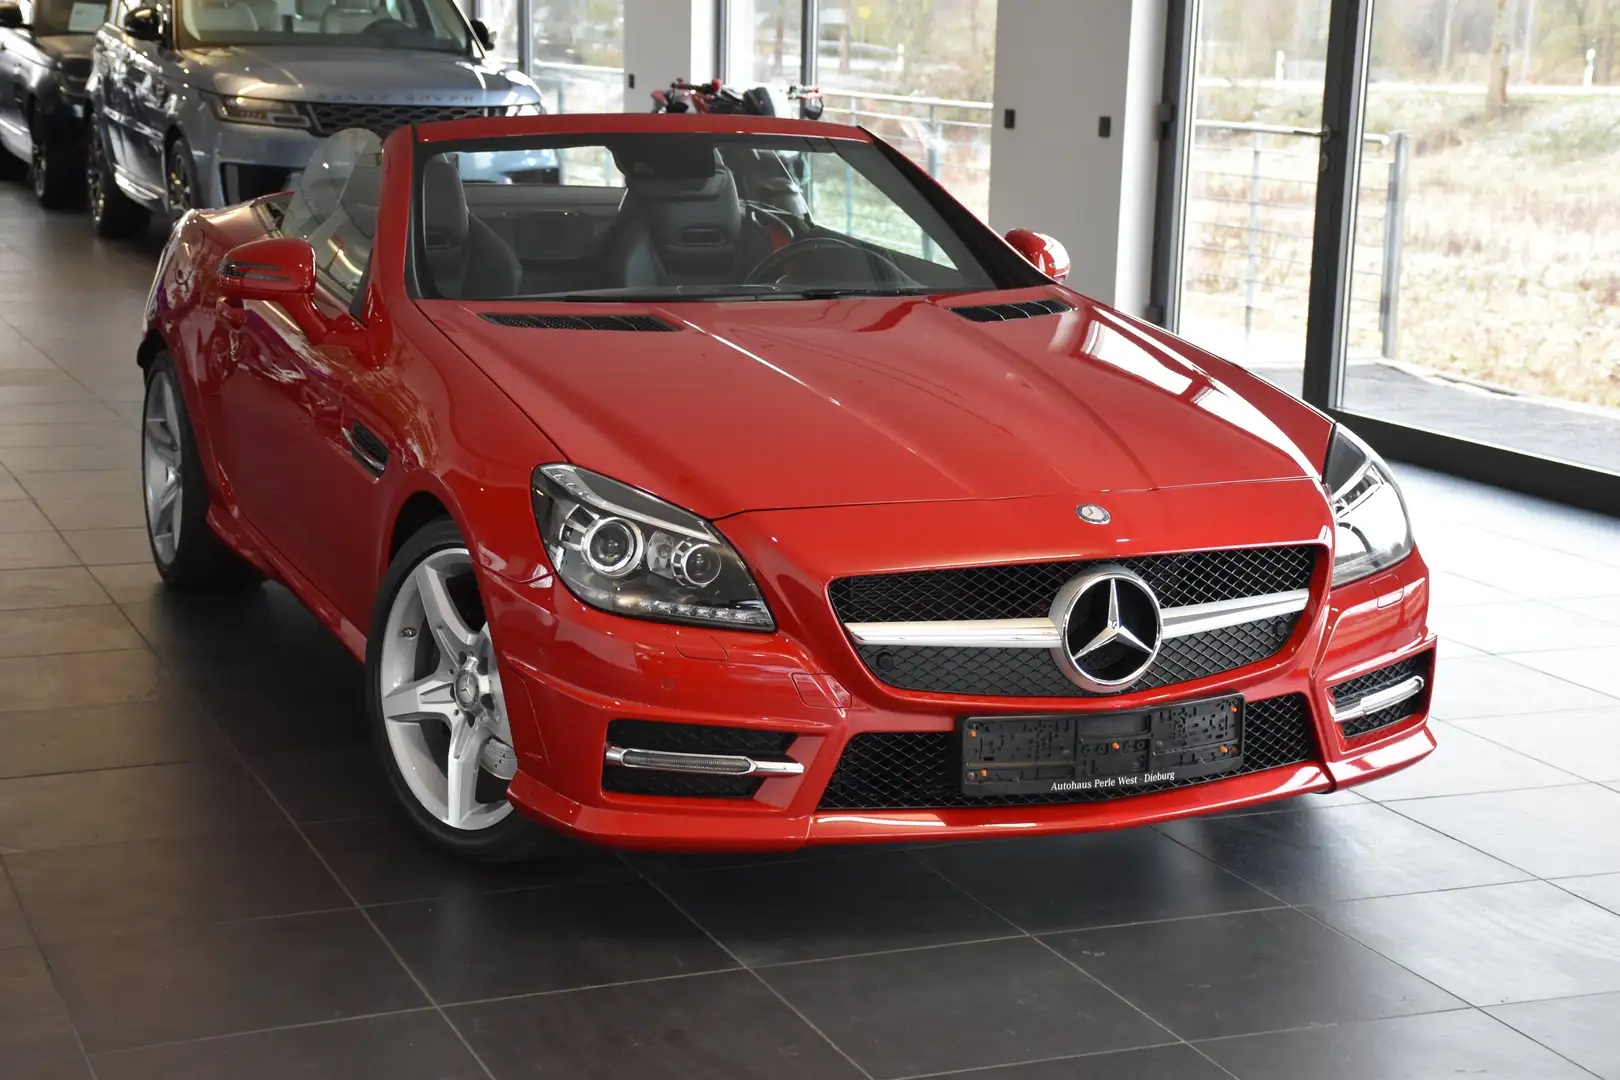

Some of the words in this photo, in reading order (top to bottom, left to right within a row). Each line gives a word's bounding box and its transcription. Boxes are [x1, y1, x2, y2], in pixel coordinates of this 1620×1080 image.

[1051, 781, 1092, 791] Autohaus
[1094, 778, 1116, 788] Perle
[1118, 776, 1138, 785] West
[1144, 771, 1175, 783] Dieburg
